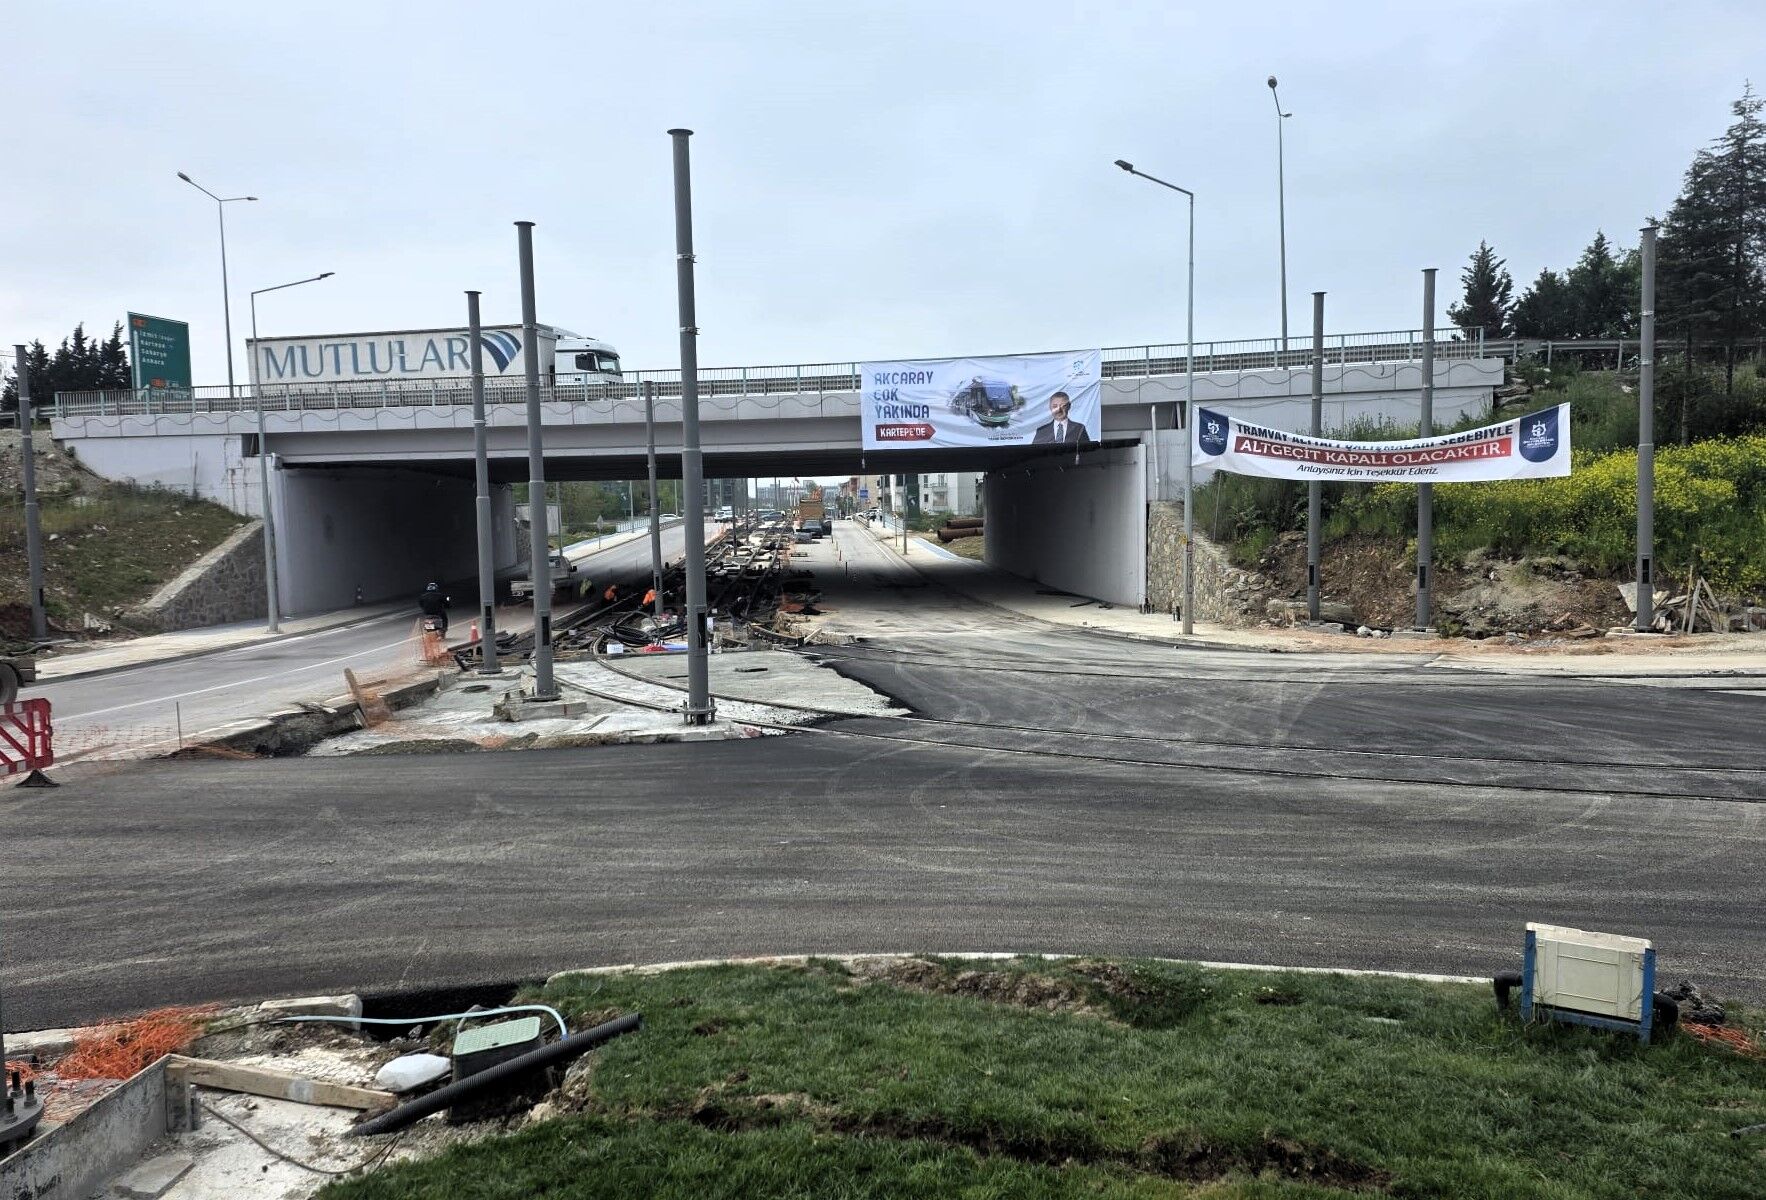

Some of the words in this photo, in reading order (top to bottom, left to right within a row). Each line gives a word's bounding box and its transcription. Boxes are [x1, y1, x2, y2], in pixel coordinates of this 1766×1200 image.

[263, 338, 471, 378] MUTLULAR
[874, 404, 930, 418] YAKINDA
[880, 427, 926, 437] KARTEPE'DE
[1236, 423, 1287, 442] TRAMVAY
[1240, 439, 1321, 460] ALTGEÇİT
[1325, 451, 1388, 465] KAPALI
[1392, 442, 1506, 464] OLACAKTIR.
